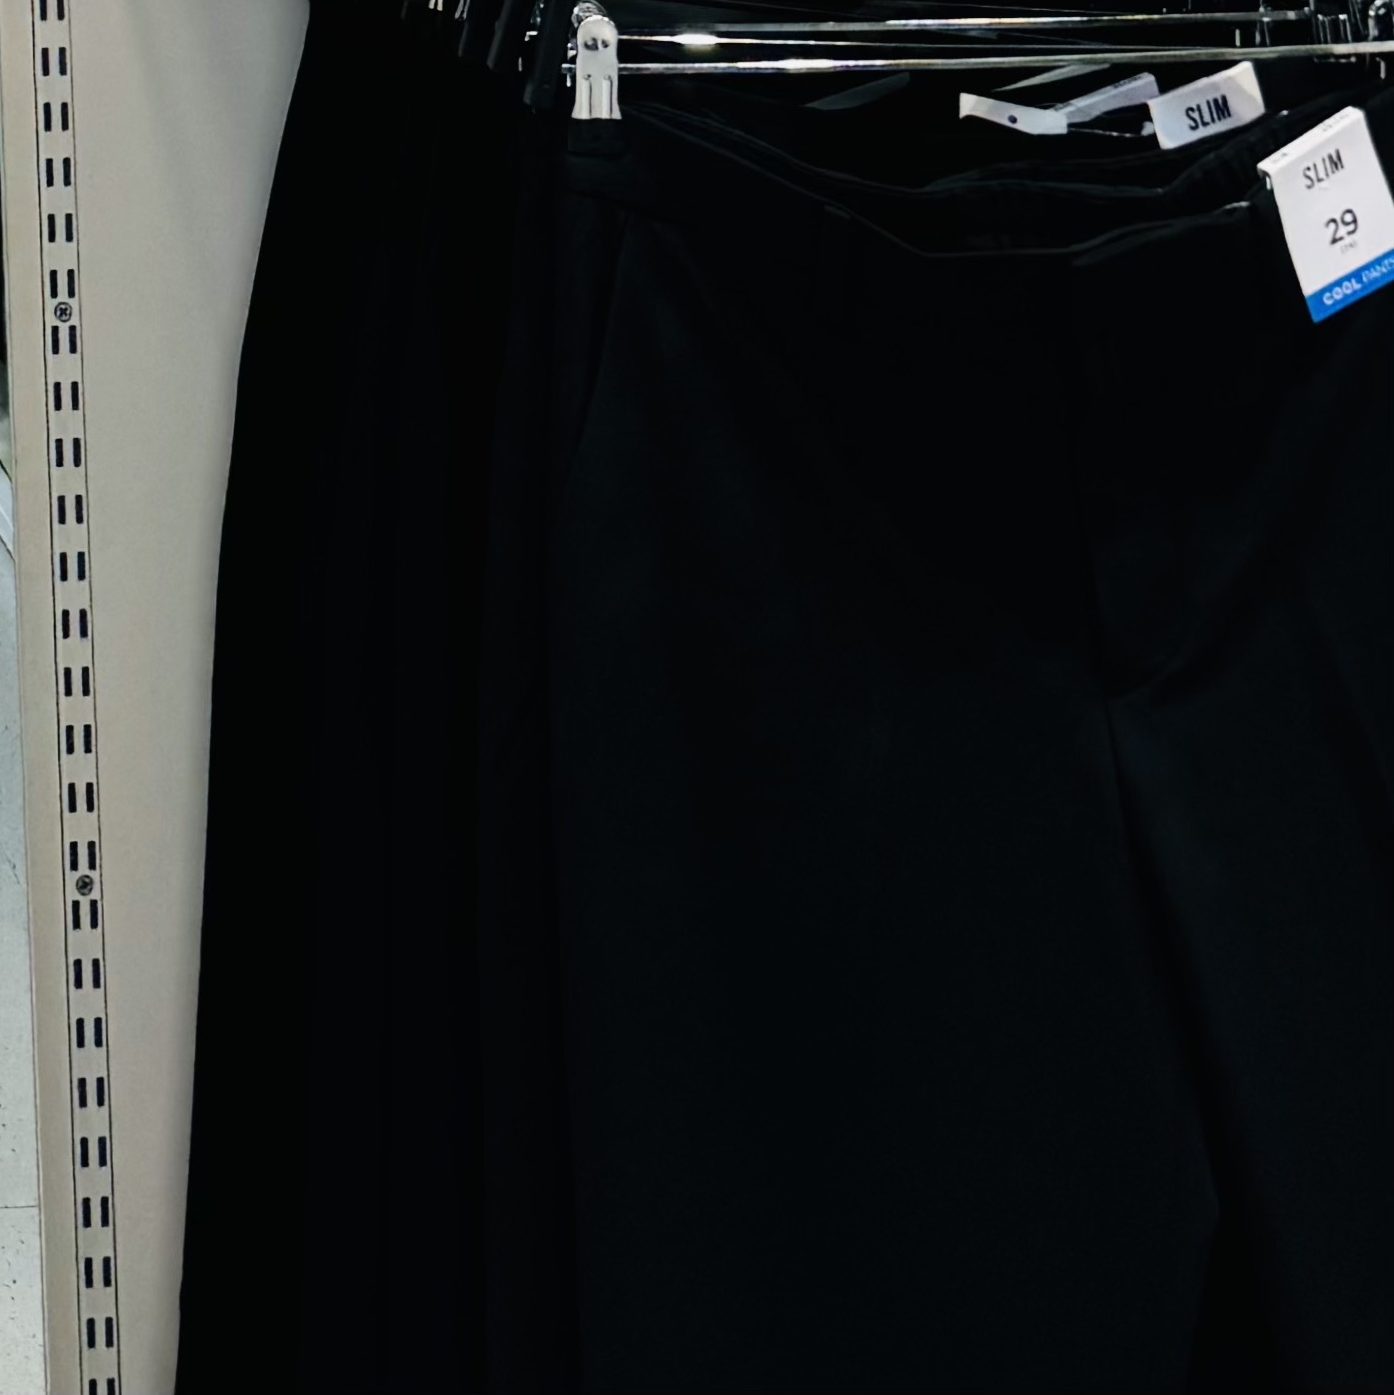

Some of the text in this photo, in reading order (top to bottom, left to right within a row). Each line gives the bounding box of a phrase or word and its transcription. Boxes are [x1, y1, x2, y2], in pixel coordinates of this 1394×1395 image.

[1185, 94, 1232, 131] SLIM
[1302, 148, 1344, 190] SLIM
[1325, 208, 1358, 245] 29
[1323, 277, 1362, 306] COOL
